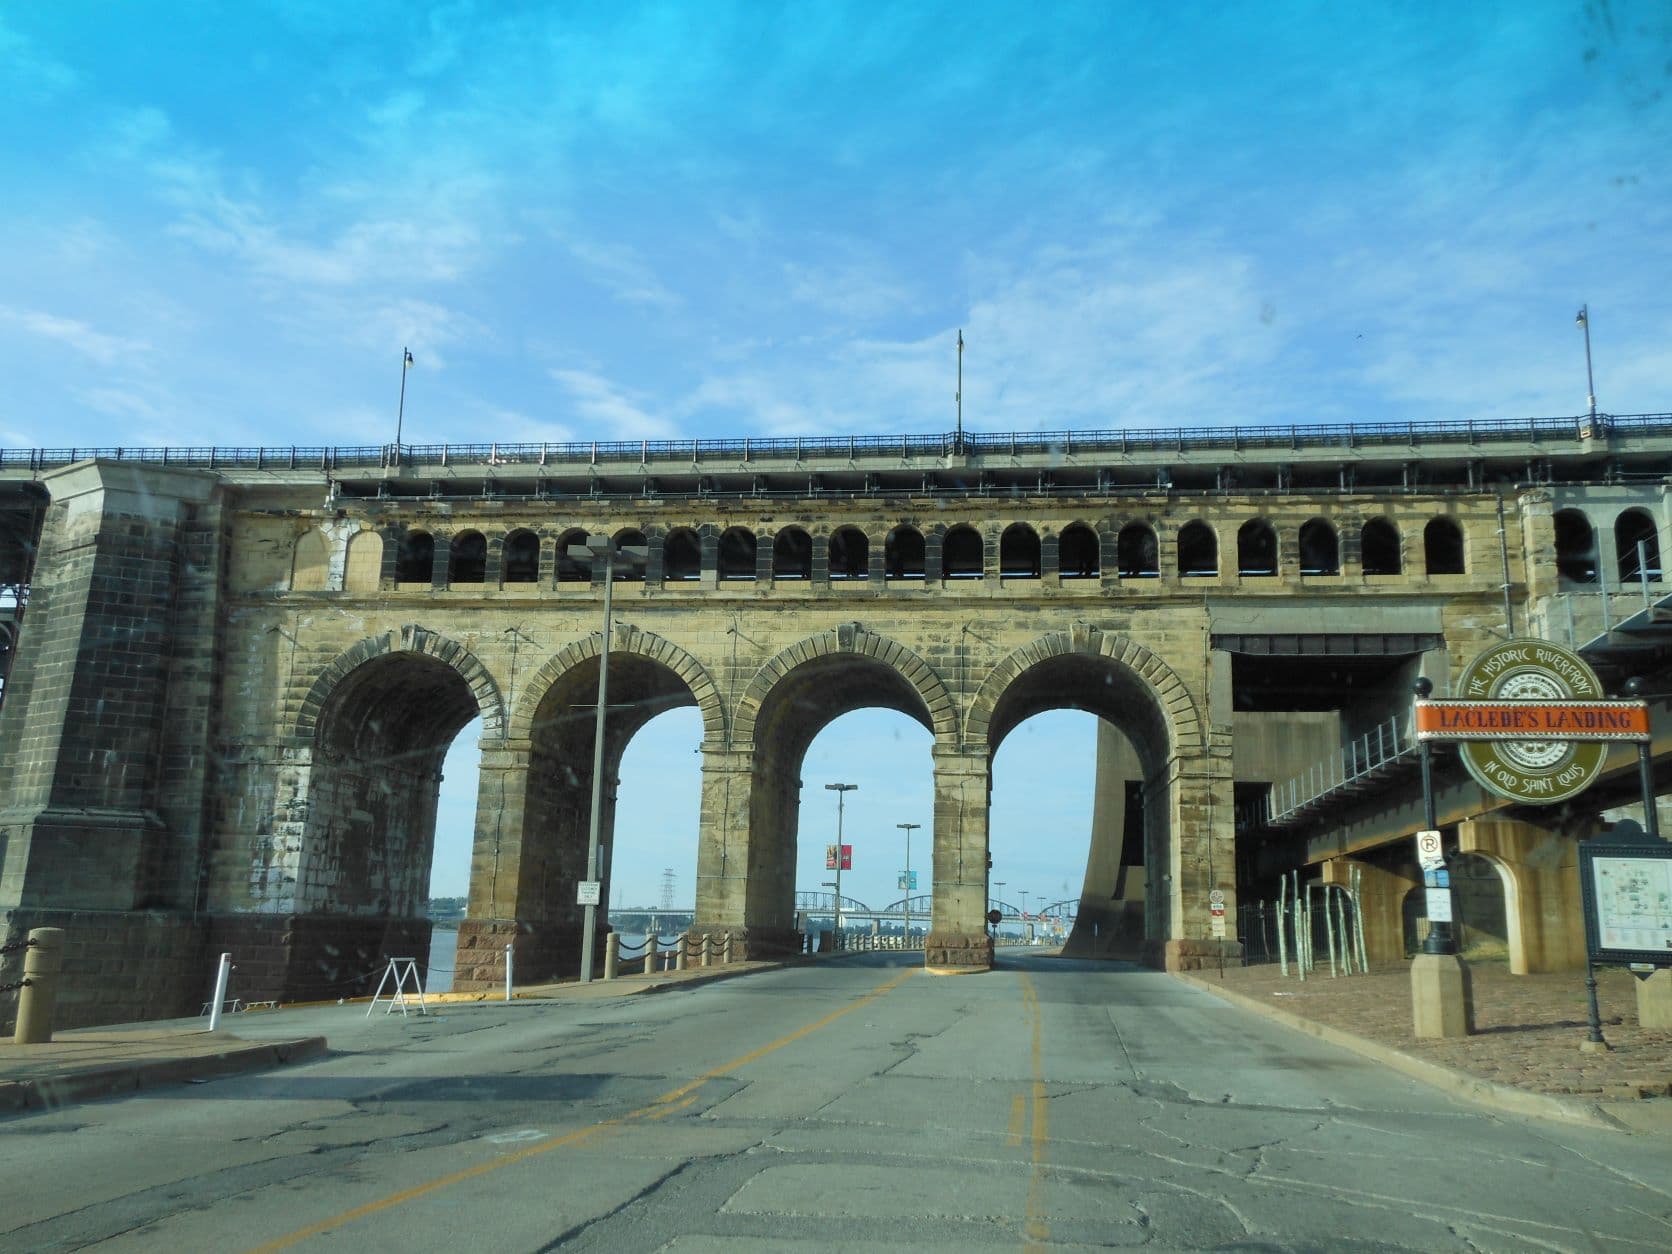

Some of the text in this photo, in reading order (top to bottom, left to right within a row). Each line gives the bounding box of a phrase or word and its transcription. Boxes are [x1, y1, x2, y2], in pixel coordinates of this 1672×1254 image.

[1468, 647, 1593, 696] THE HISTORIC RIVERFRONT
[1440, 710, 1632, 729] LACLEDE'S LANDING
[1483, 760, 1585, 794] IN OLD SAINT LOUIS
